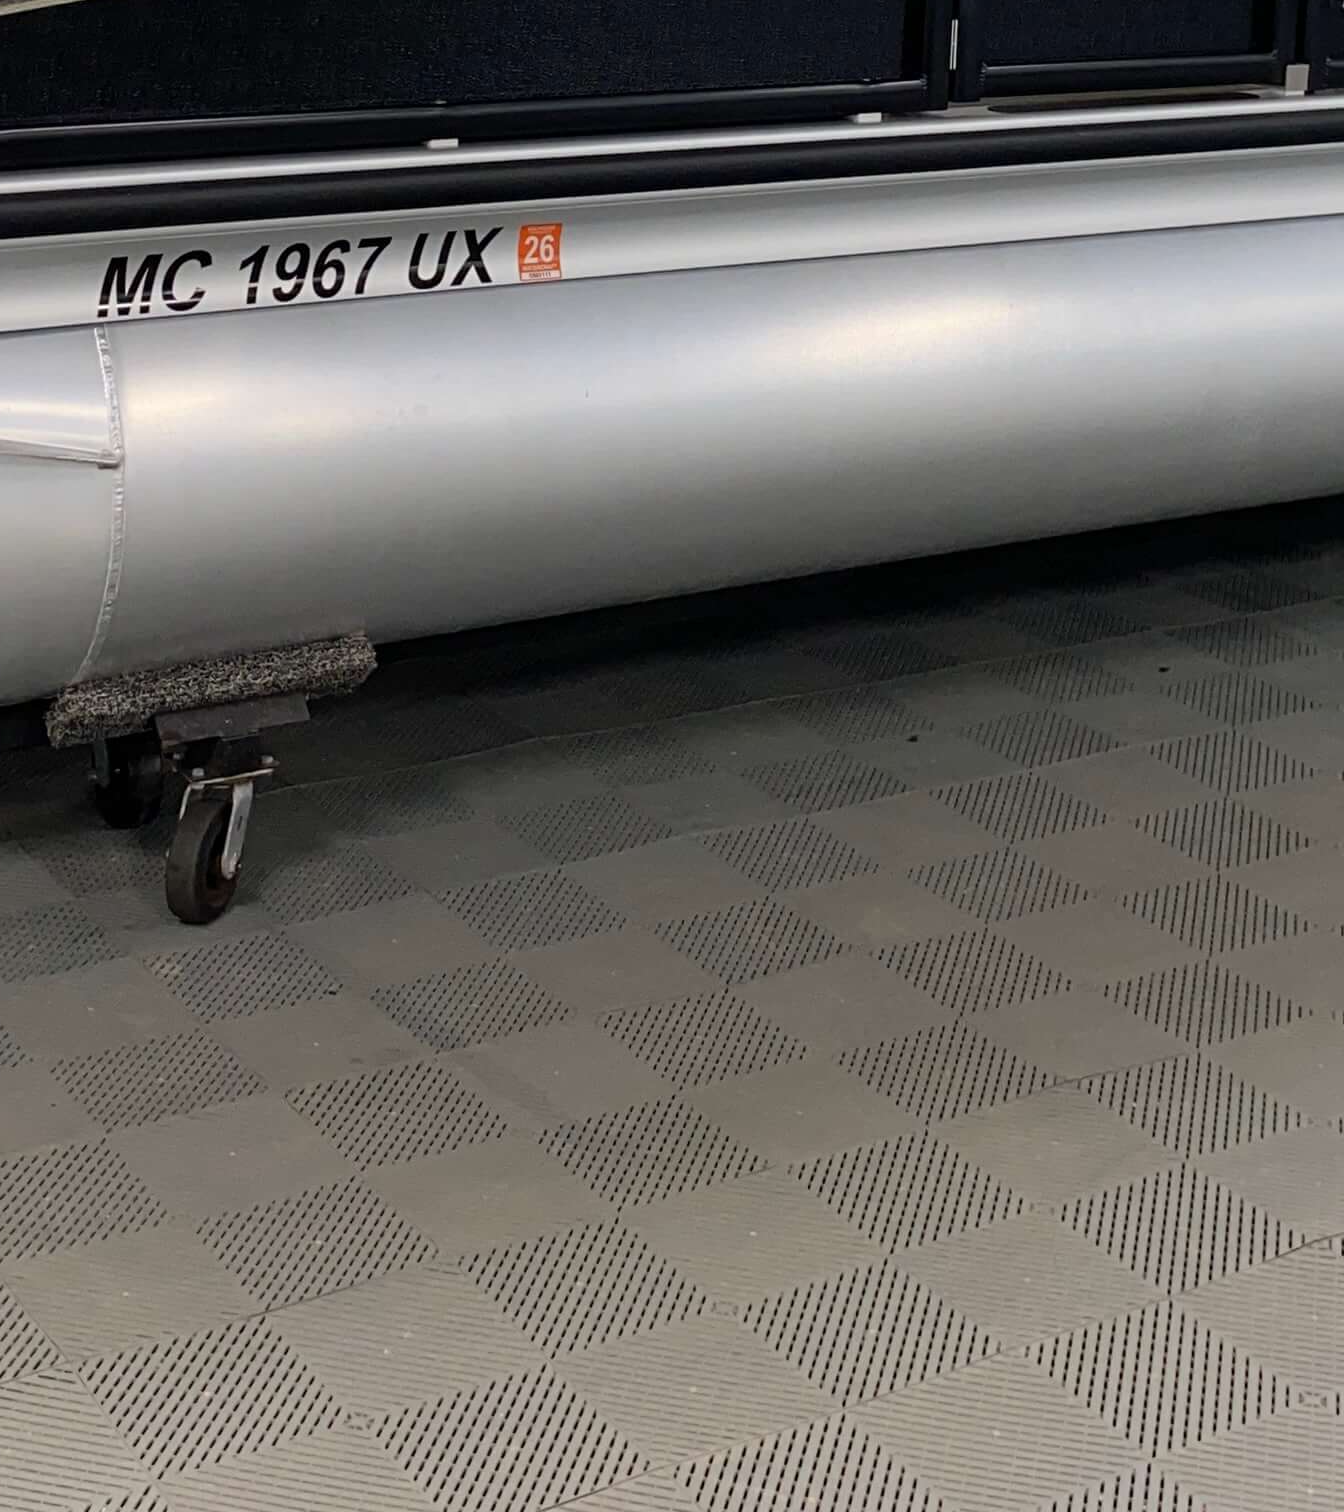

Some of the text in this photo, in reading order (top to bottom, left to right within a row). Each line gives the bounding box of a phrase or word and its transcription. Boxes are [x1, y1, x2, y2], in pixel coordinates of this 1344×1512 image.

[96, 226, 503, 318] MC 1967 UX
[523, 234, 555, 264] 26
